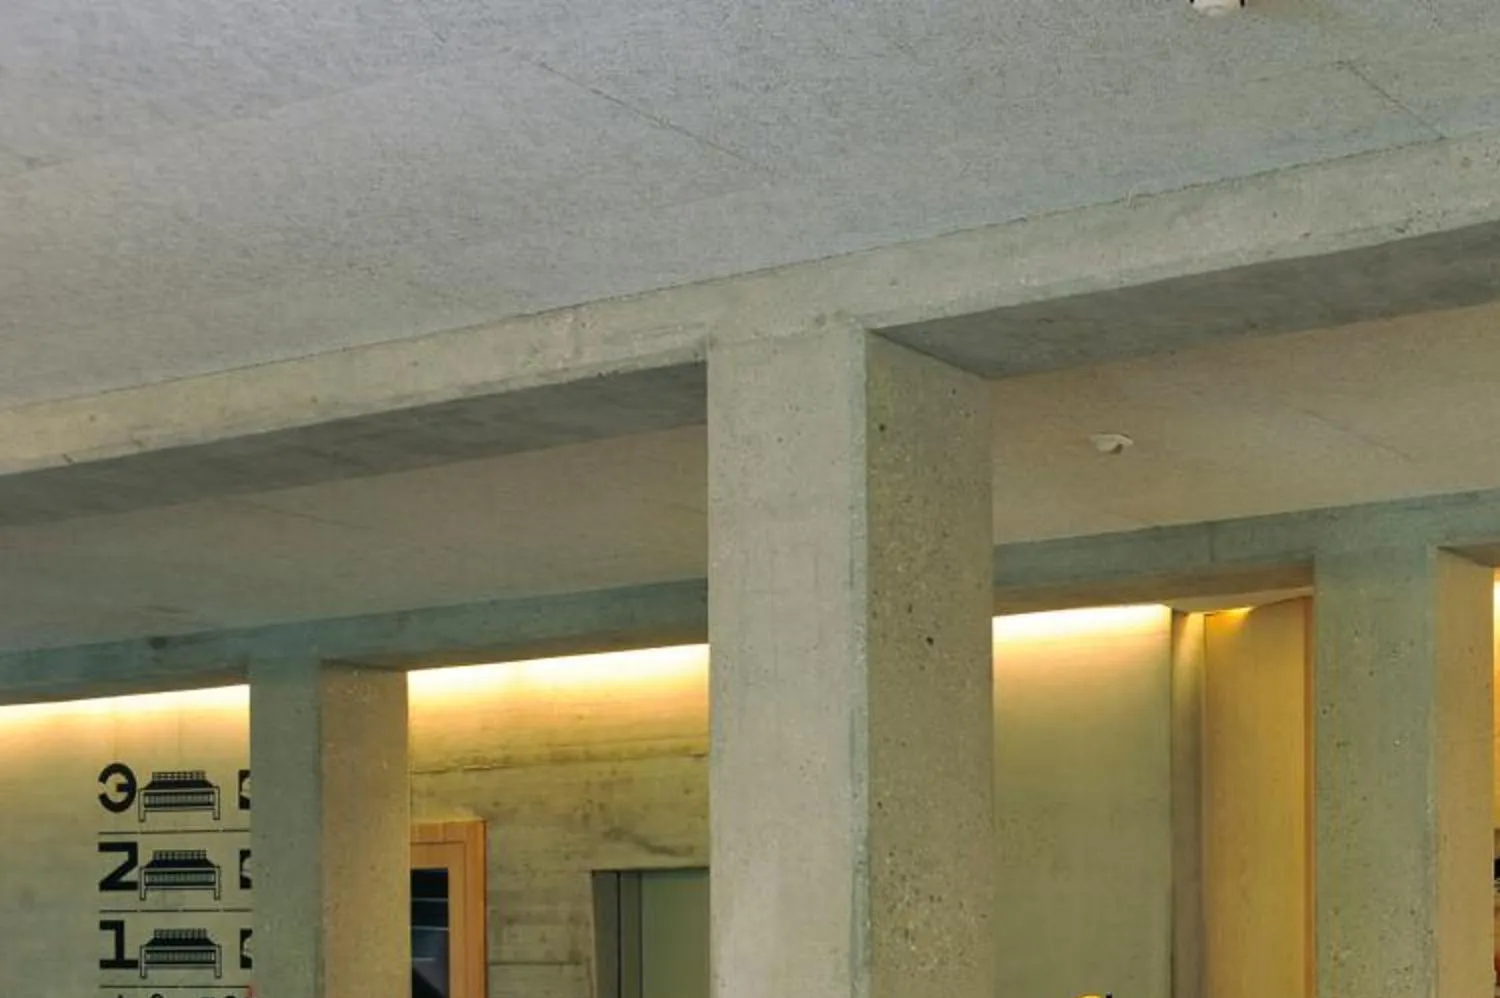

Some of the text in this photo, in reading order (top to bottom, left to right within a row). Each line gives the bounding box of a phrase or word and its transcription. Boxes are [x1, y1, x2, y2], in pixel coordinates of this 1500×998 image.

[98, 763, 137, 813] 3
[98, 842, 138, 892] 2
[99, 920, 139, 970] 1
